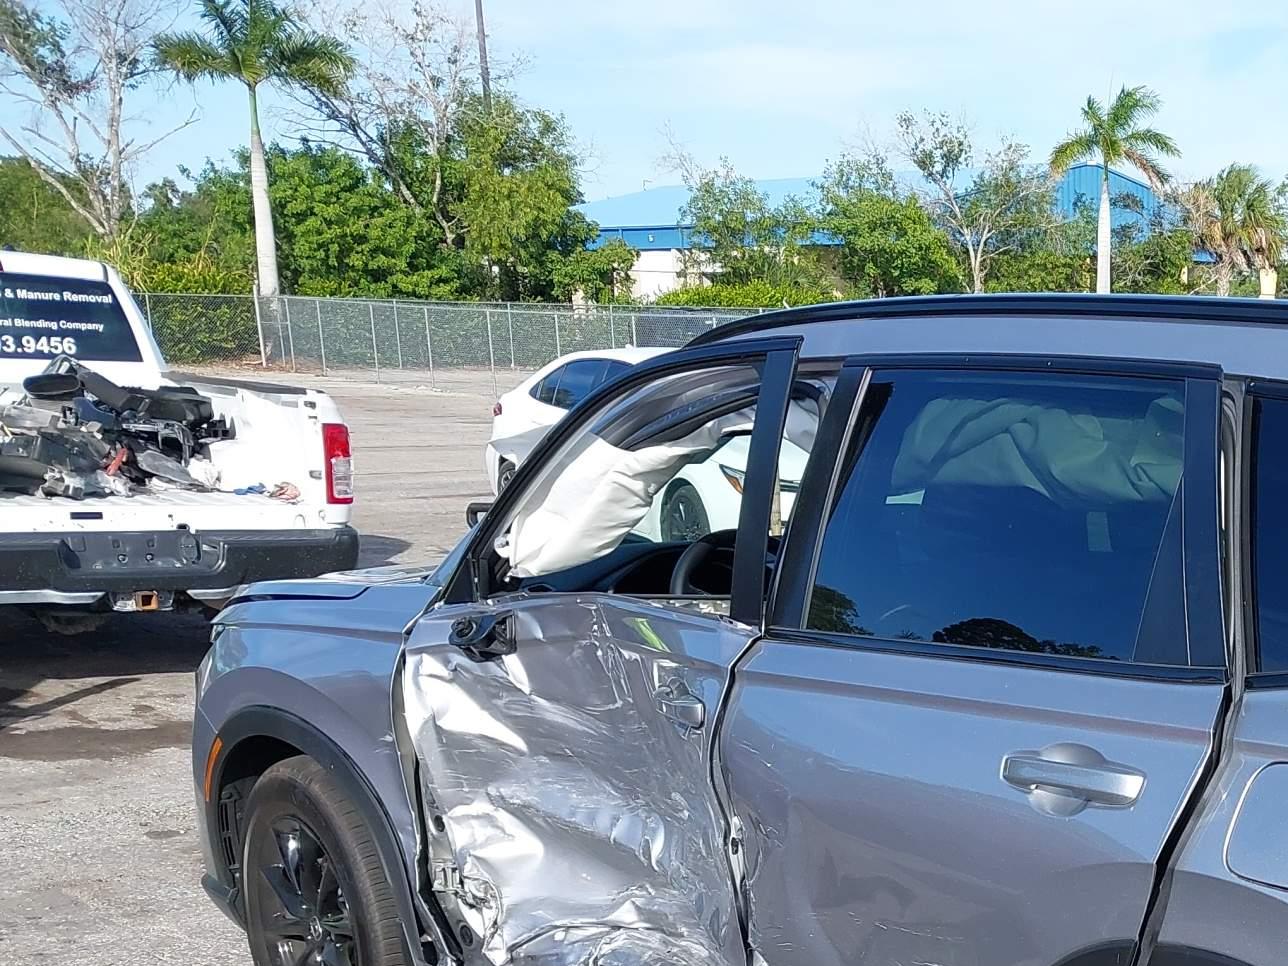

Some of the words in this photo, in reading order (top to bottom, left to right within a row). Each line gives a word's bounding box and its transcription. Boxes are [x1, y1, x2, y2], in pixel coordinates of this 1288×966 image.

[4, 288, 14, 298] &
[16, 288, 61, 301] Manure
[63, 291, 113, 304] Removal
[14, 319, 58, 330] Blending
[59, 320, 104, 332] Company
[0, 335, 77, 355] 3.9456
